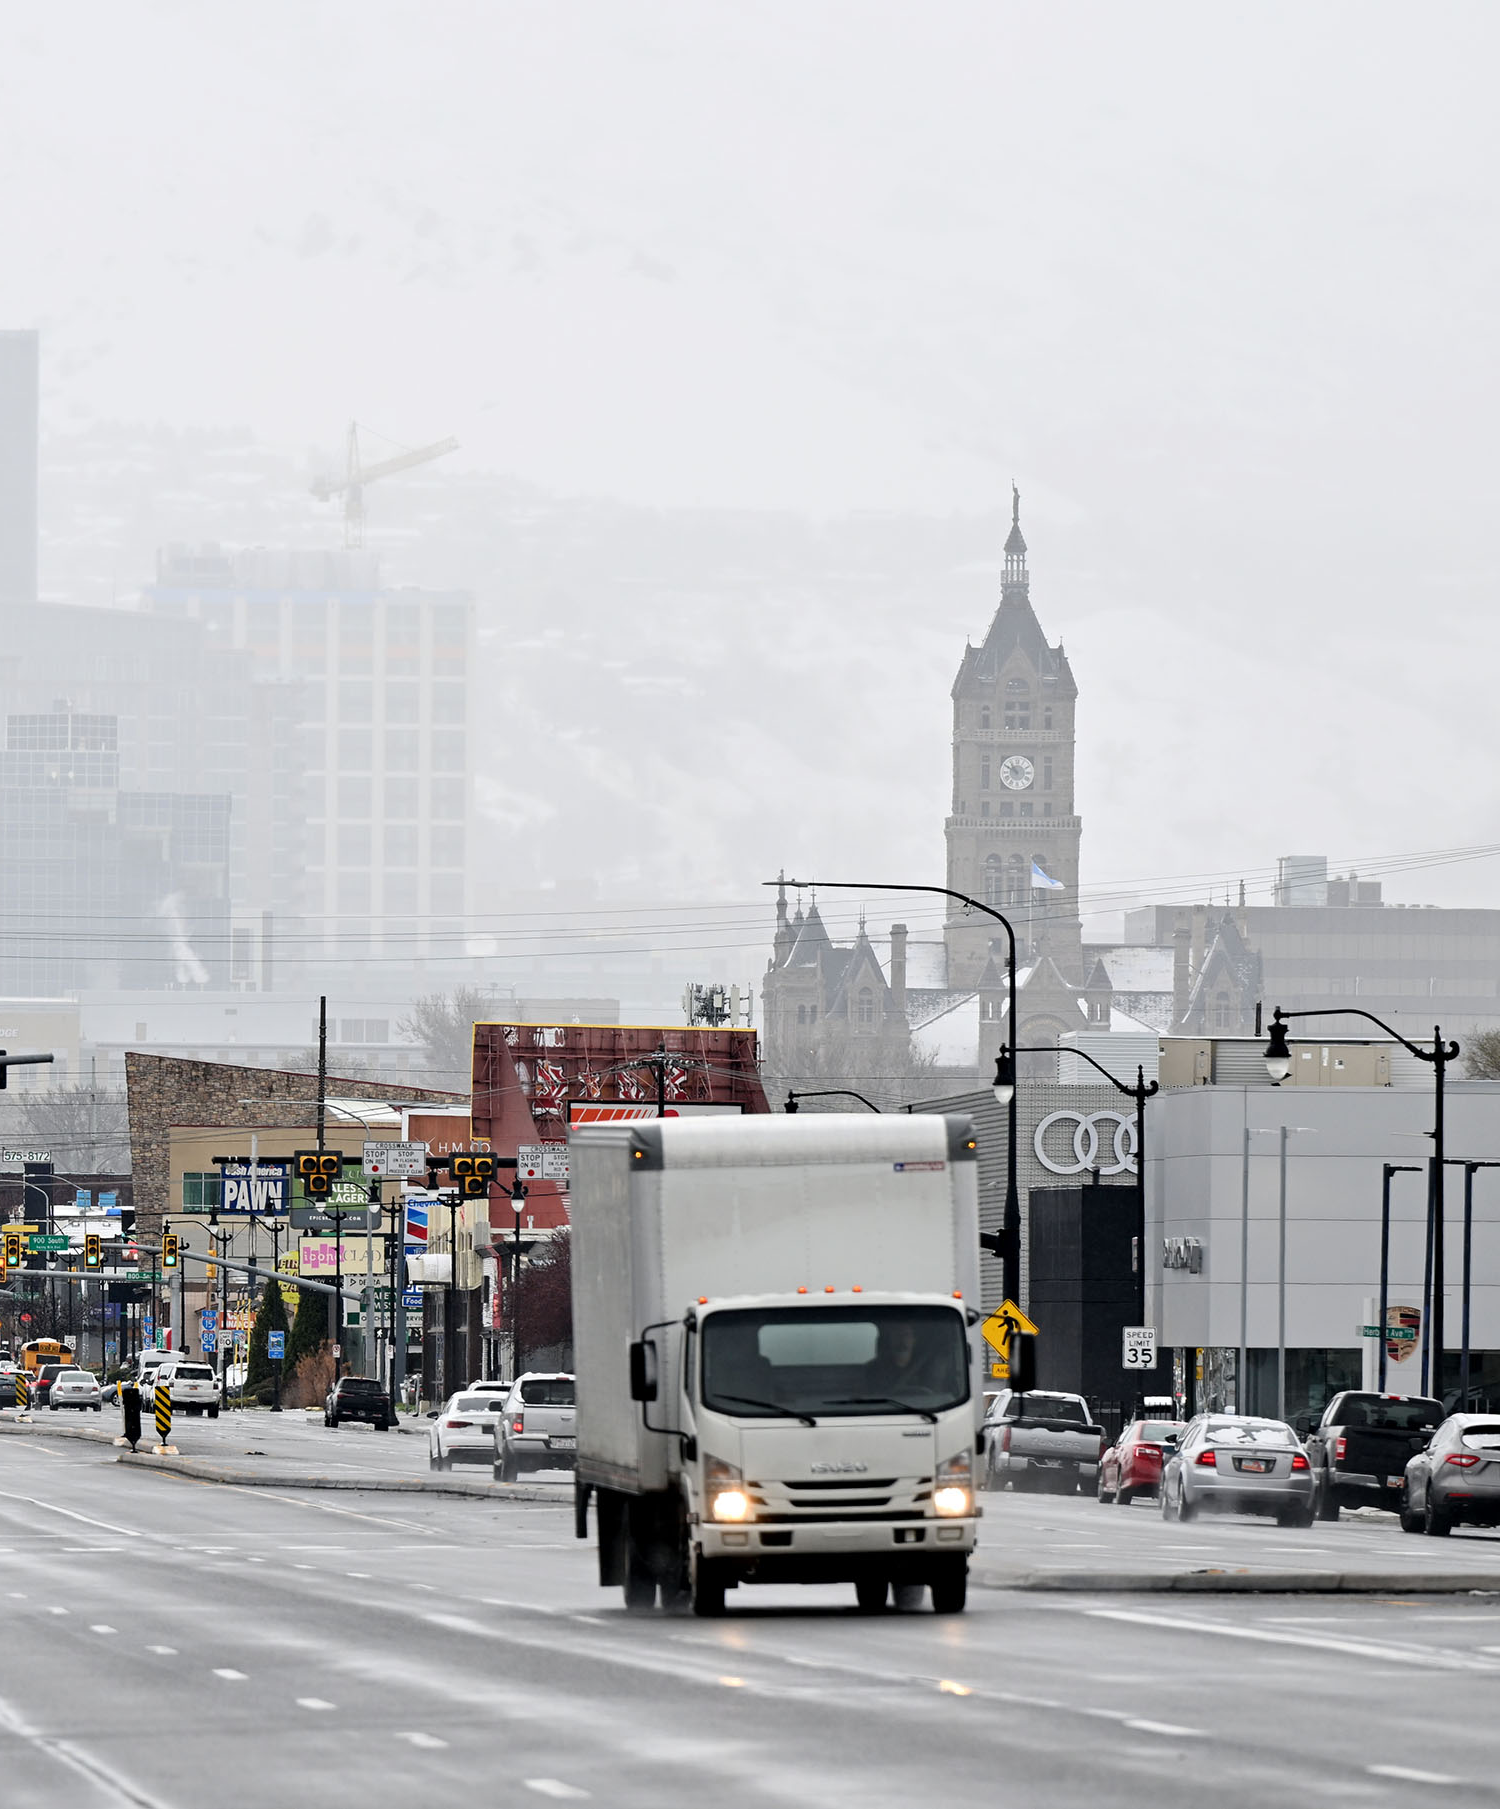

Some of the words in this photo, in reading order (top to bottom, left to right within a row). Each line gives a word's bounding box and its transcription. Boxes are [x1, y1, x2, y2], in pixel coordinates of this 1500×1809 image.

[4, 1151, 50, 1161] 575-8172
[365, 1150, 386, 1158] STOP
[520, 1154, 541, 1162] STOP
[224, 1180, 283, 1210] PAWN
[32, 1236, 45, 1244] 900
[47, 1236, 65, 1244] South
[127, 1272, 141, 1280] 800
[142, 1272, 161, 1280] Souh
[205, 1321, 213, 1330] 15
[1126, 1331, 1154, 1339] SPEED
[1363, 1327, 1389, 1337] Herbt
[1390, 1329, 1404, 1338] Ave
[203, 1334, 214, 1343] 80
[1126, 1348, 1153, 1364] 35
[811, 1461, 868, 1474] ISUZU
